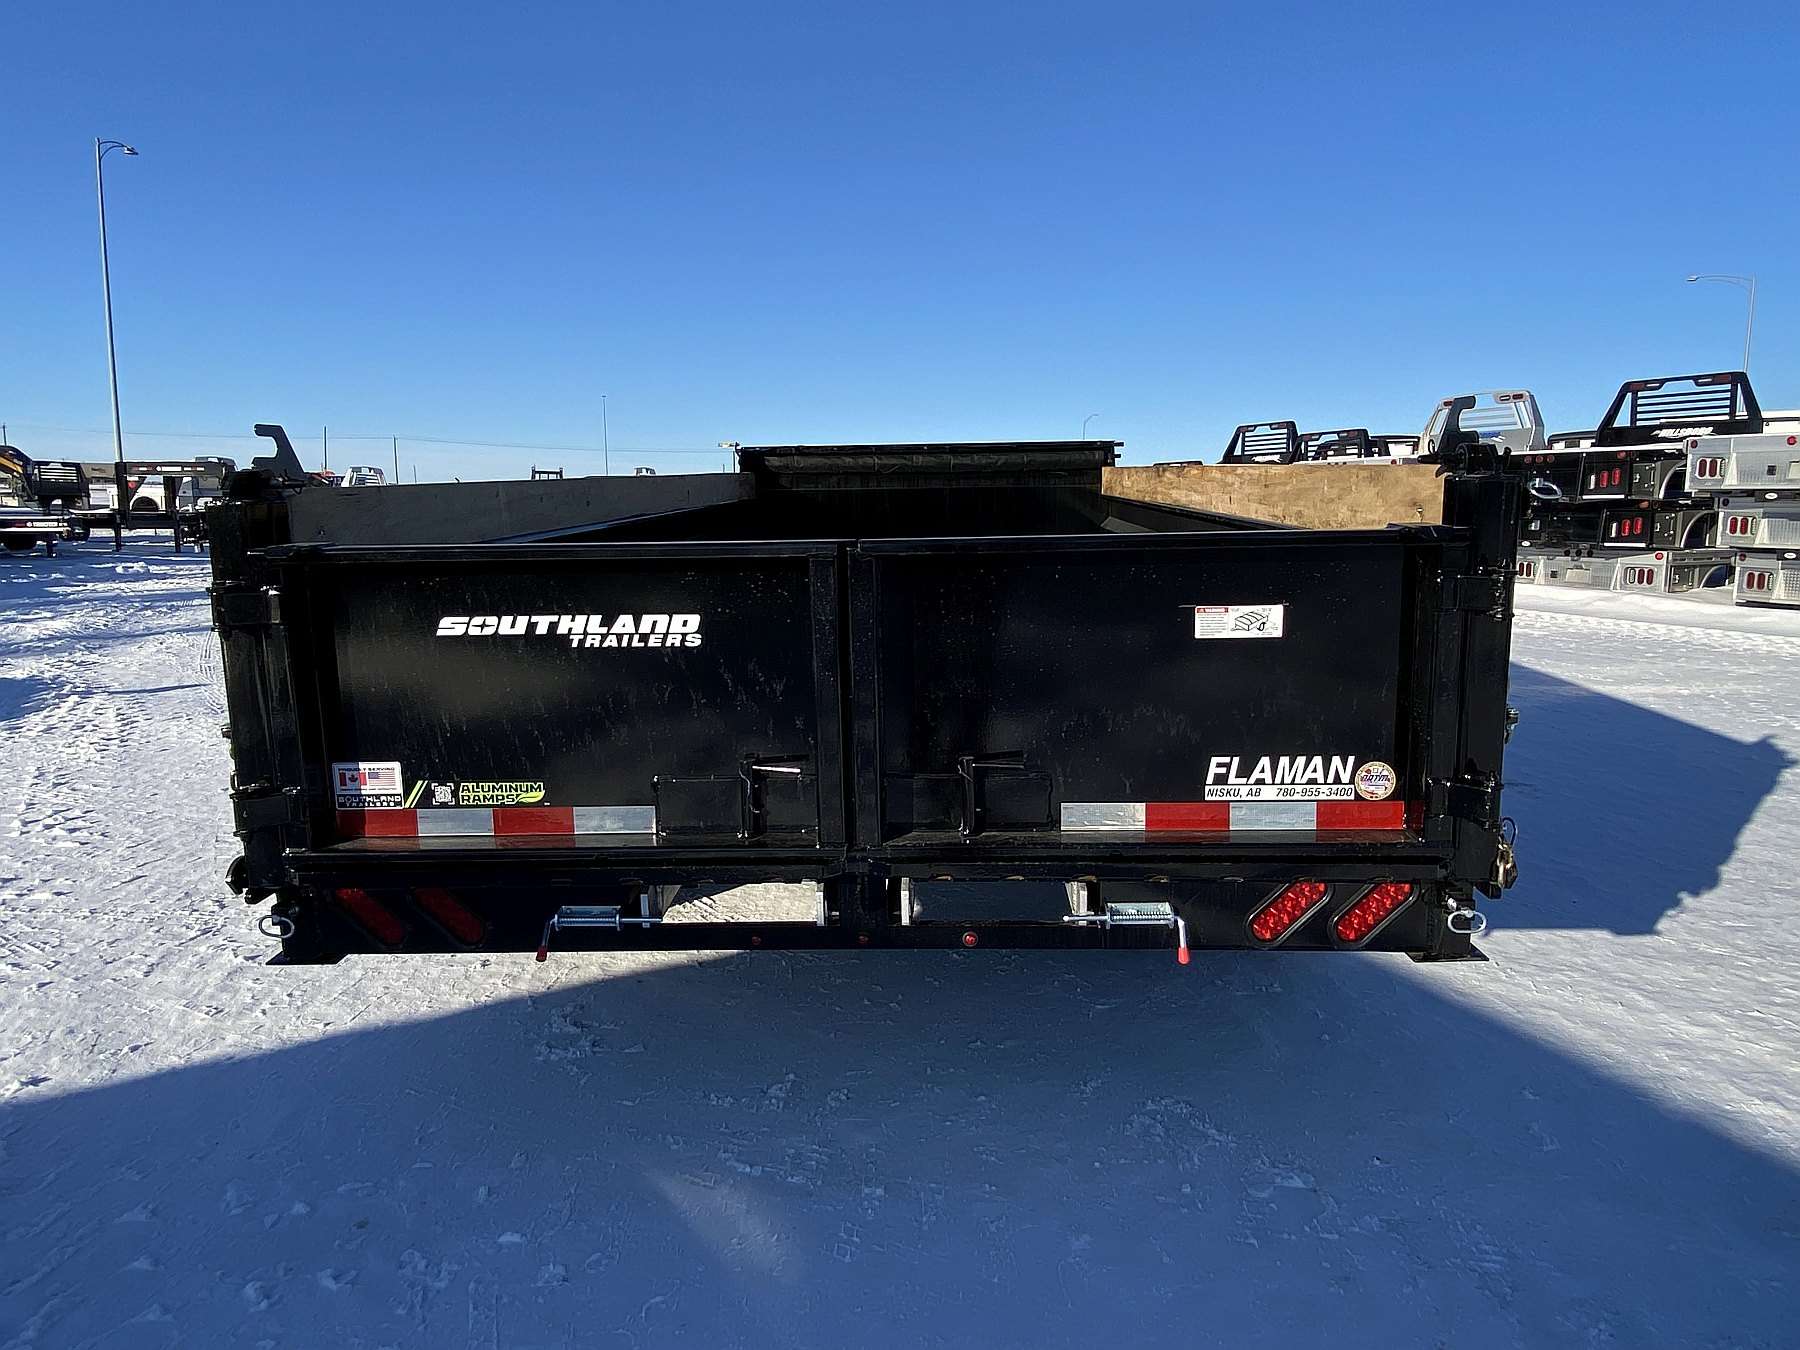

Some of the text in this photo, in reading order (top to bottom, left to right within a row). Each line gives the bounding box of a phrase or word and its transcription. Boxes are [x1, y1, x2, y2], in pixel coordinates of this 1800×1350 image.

[436, 614, 701, 636] SOUTHLAND
[569, 634, 702, 648] TRAILERS
[1206, 755, 1355, 784] FLAMAN
[460, 783, 543, 793] ALUMINUM
[1207, 787, 1353, 798] NISKU, AB 780-955-3400
[460, 794, 517, 804] RAMPS
